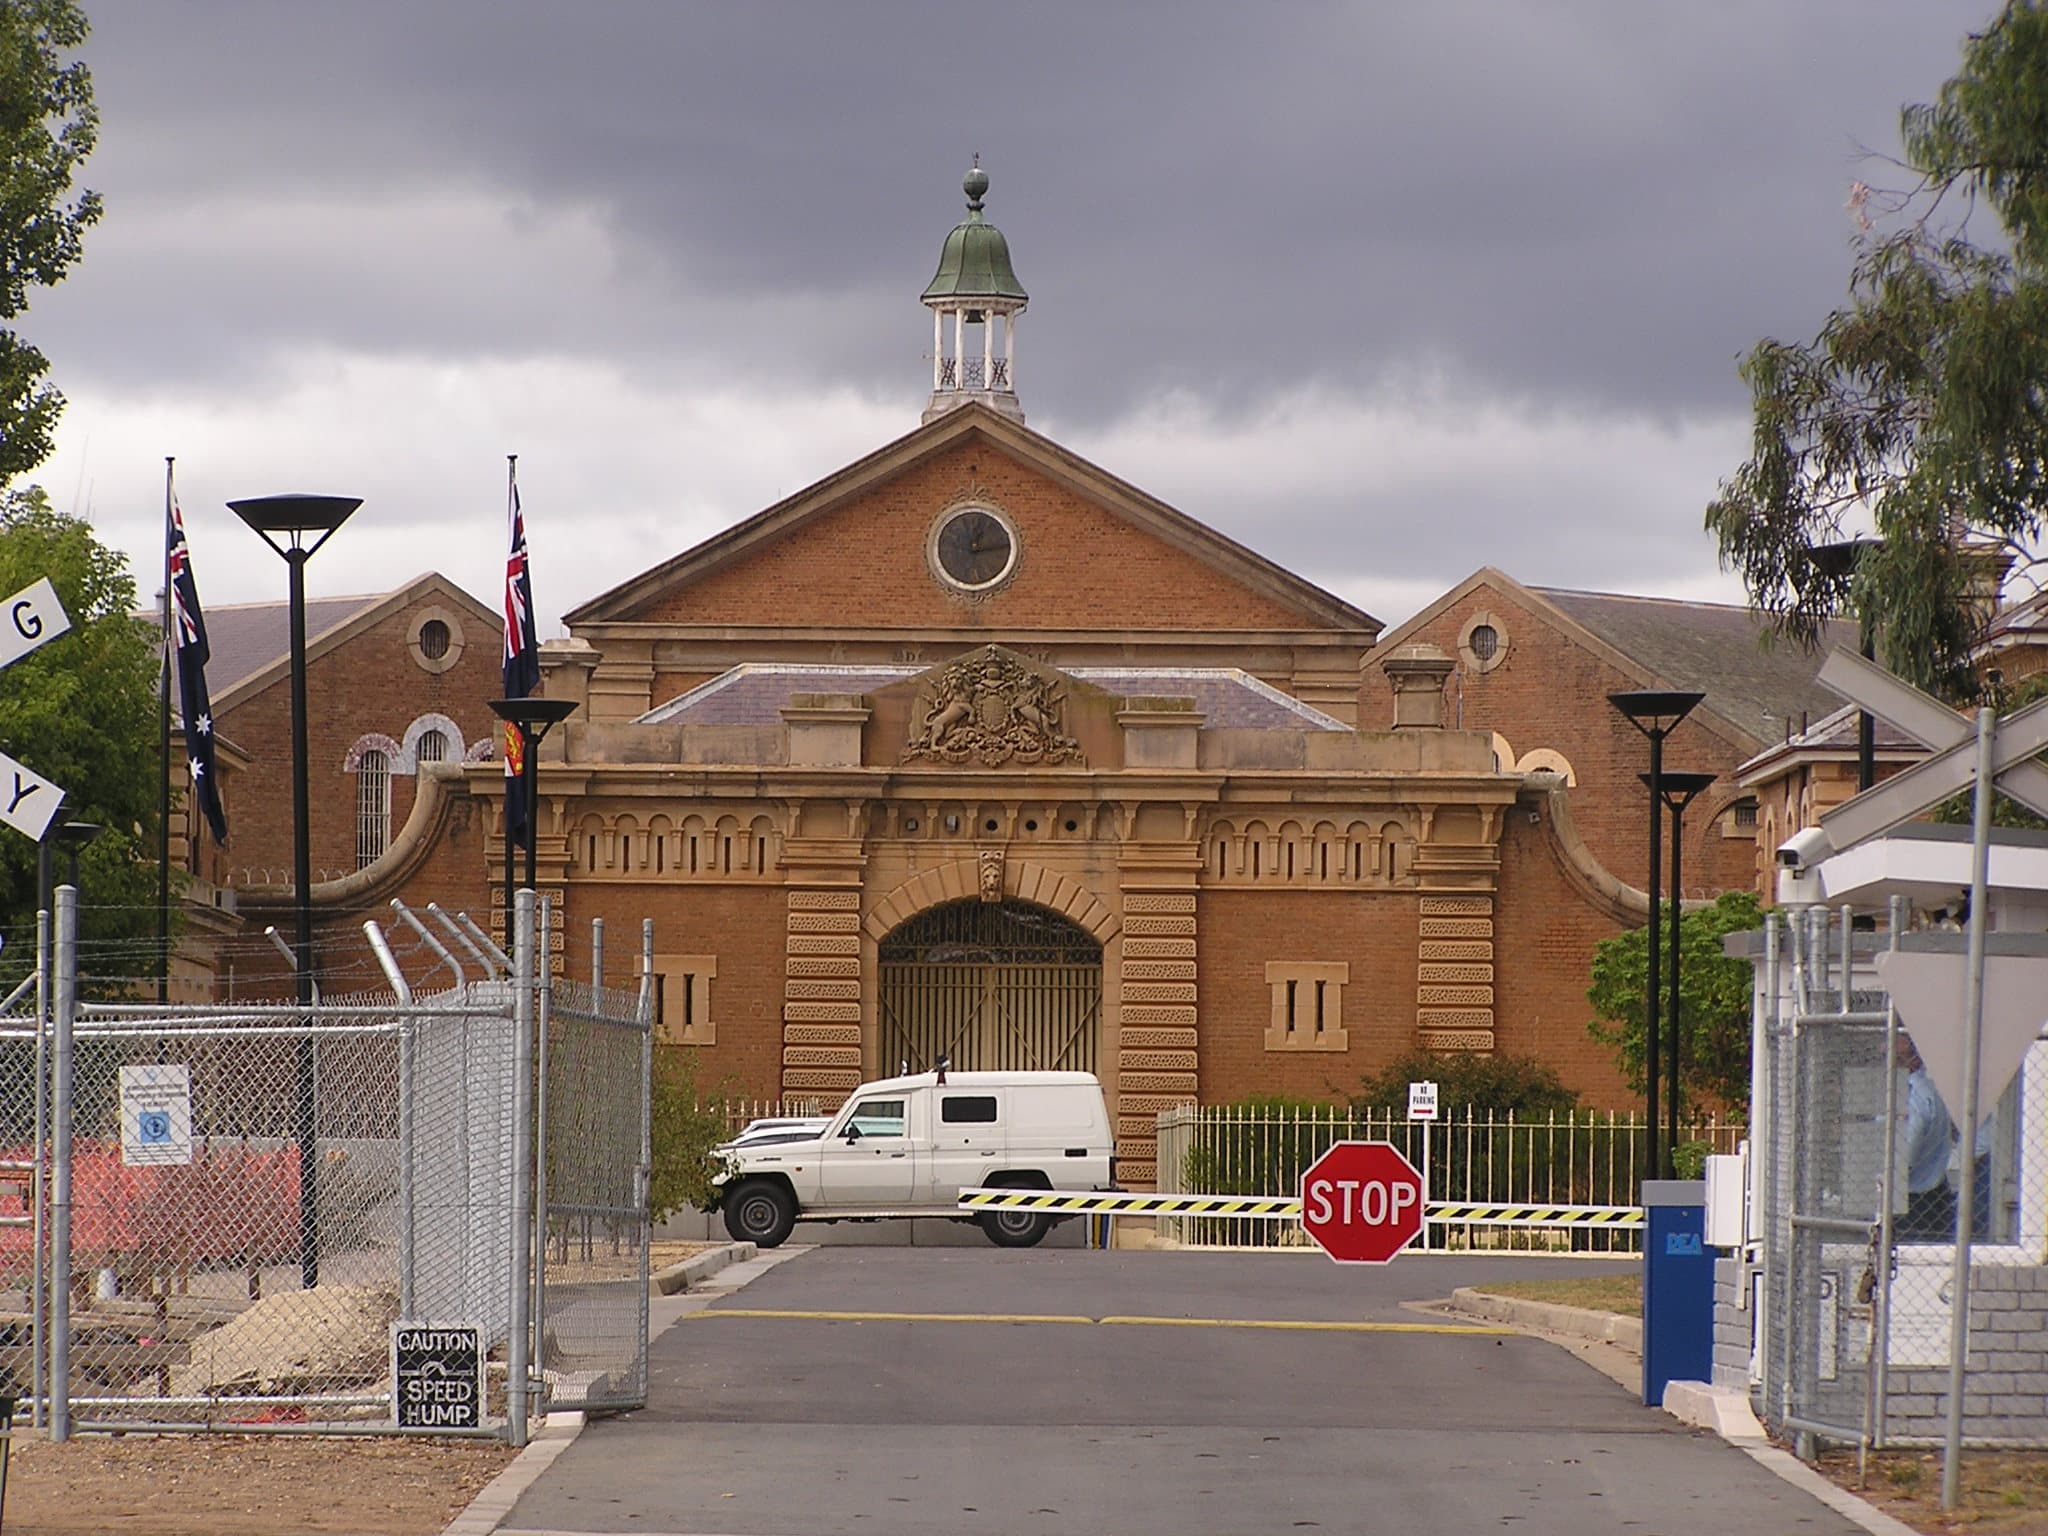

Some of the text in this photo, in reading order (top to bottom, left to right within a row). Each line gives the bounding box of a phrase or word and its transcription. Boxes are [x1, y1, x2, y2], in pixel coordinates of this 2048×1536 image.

[1308, 1180, 1416, 1225] STOP
[398, 1332, 476, 1351] CAUTION
[407, 1380, 471, 1402] SPEED
[407, 1404, 470, 1425] HUMP
